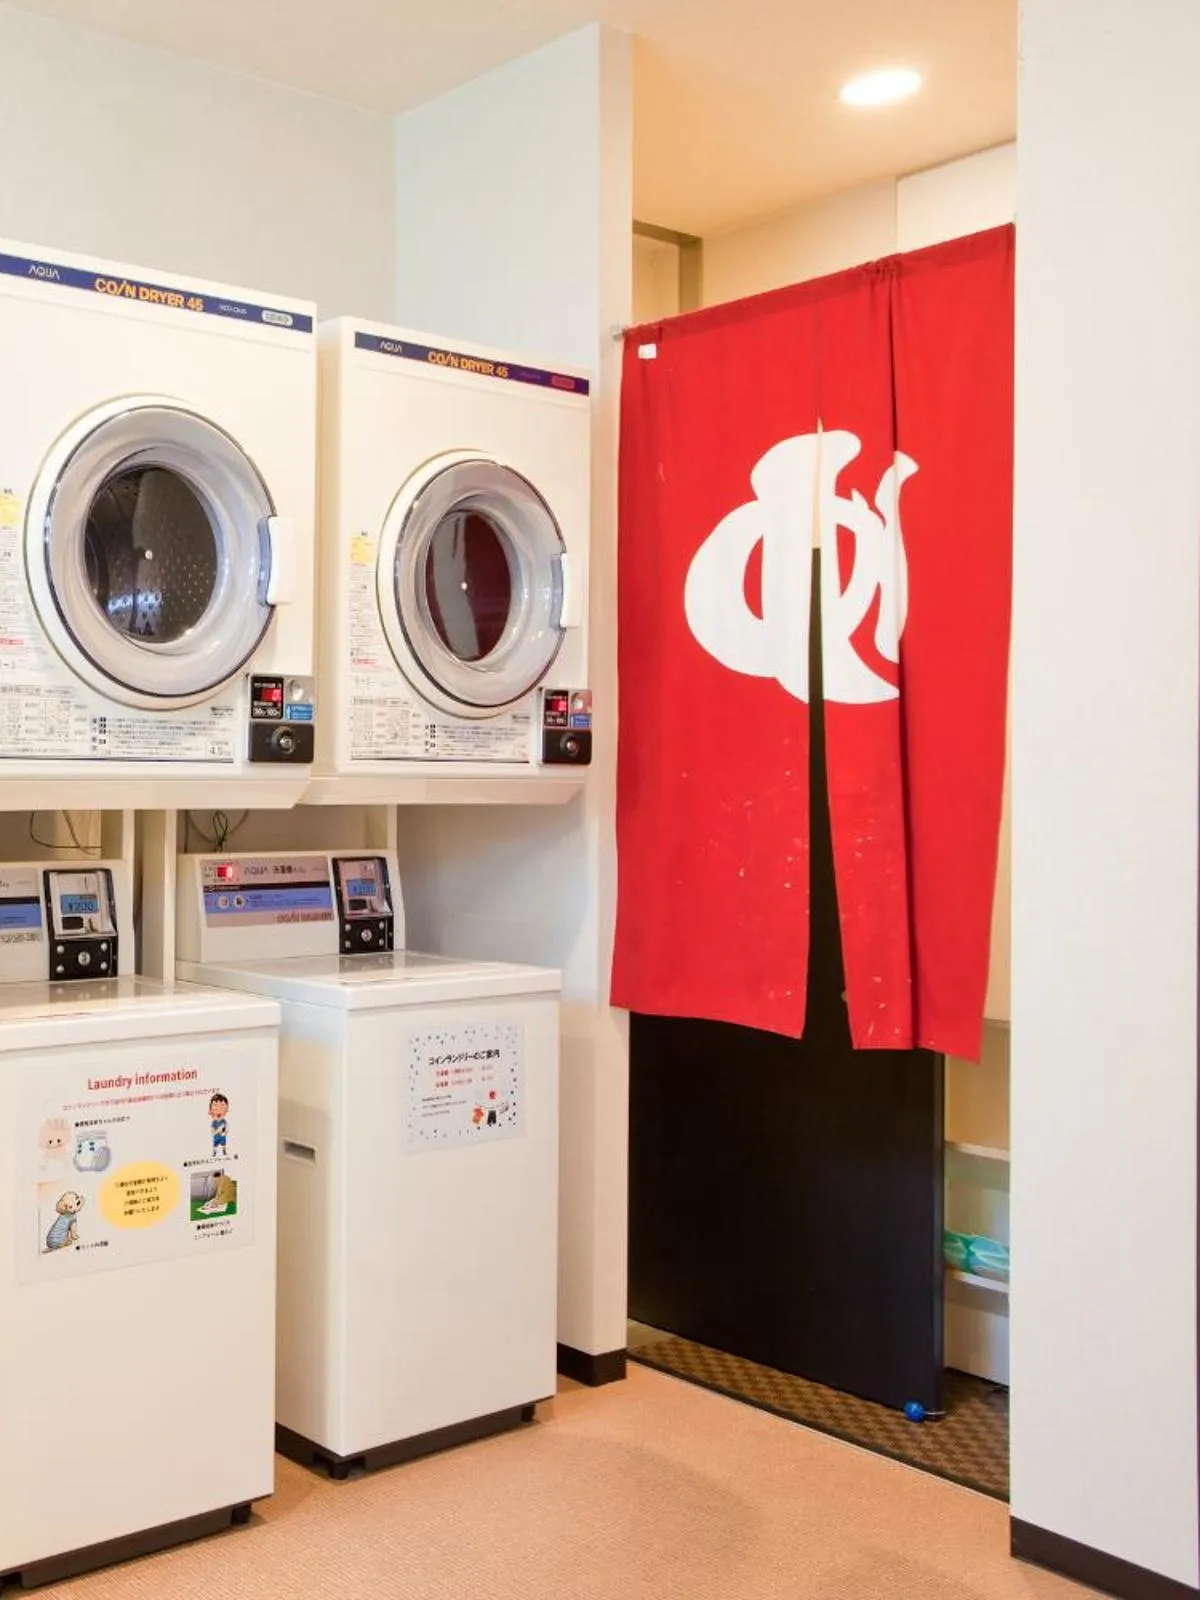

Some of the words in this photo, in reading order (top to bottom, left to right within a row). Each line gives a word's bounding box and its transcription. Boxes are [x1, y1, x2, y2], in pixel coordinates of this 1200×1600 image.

[28, 264, 60, 280] AQUA
[139, 288, 185, 309] DRYER
[187, 297, 204, 312] 45
[380, 340, 402, 353] AQUA
[460, 358, 494, 375] DRYER
[495, 365, 509, 378] 45
[244, 866, 269, 876] AQUA
[87, 1075, 132, 1091] Laundry
[135, 1069, 198, 1085] information
